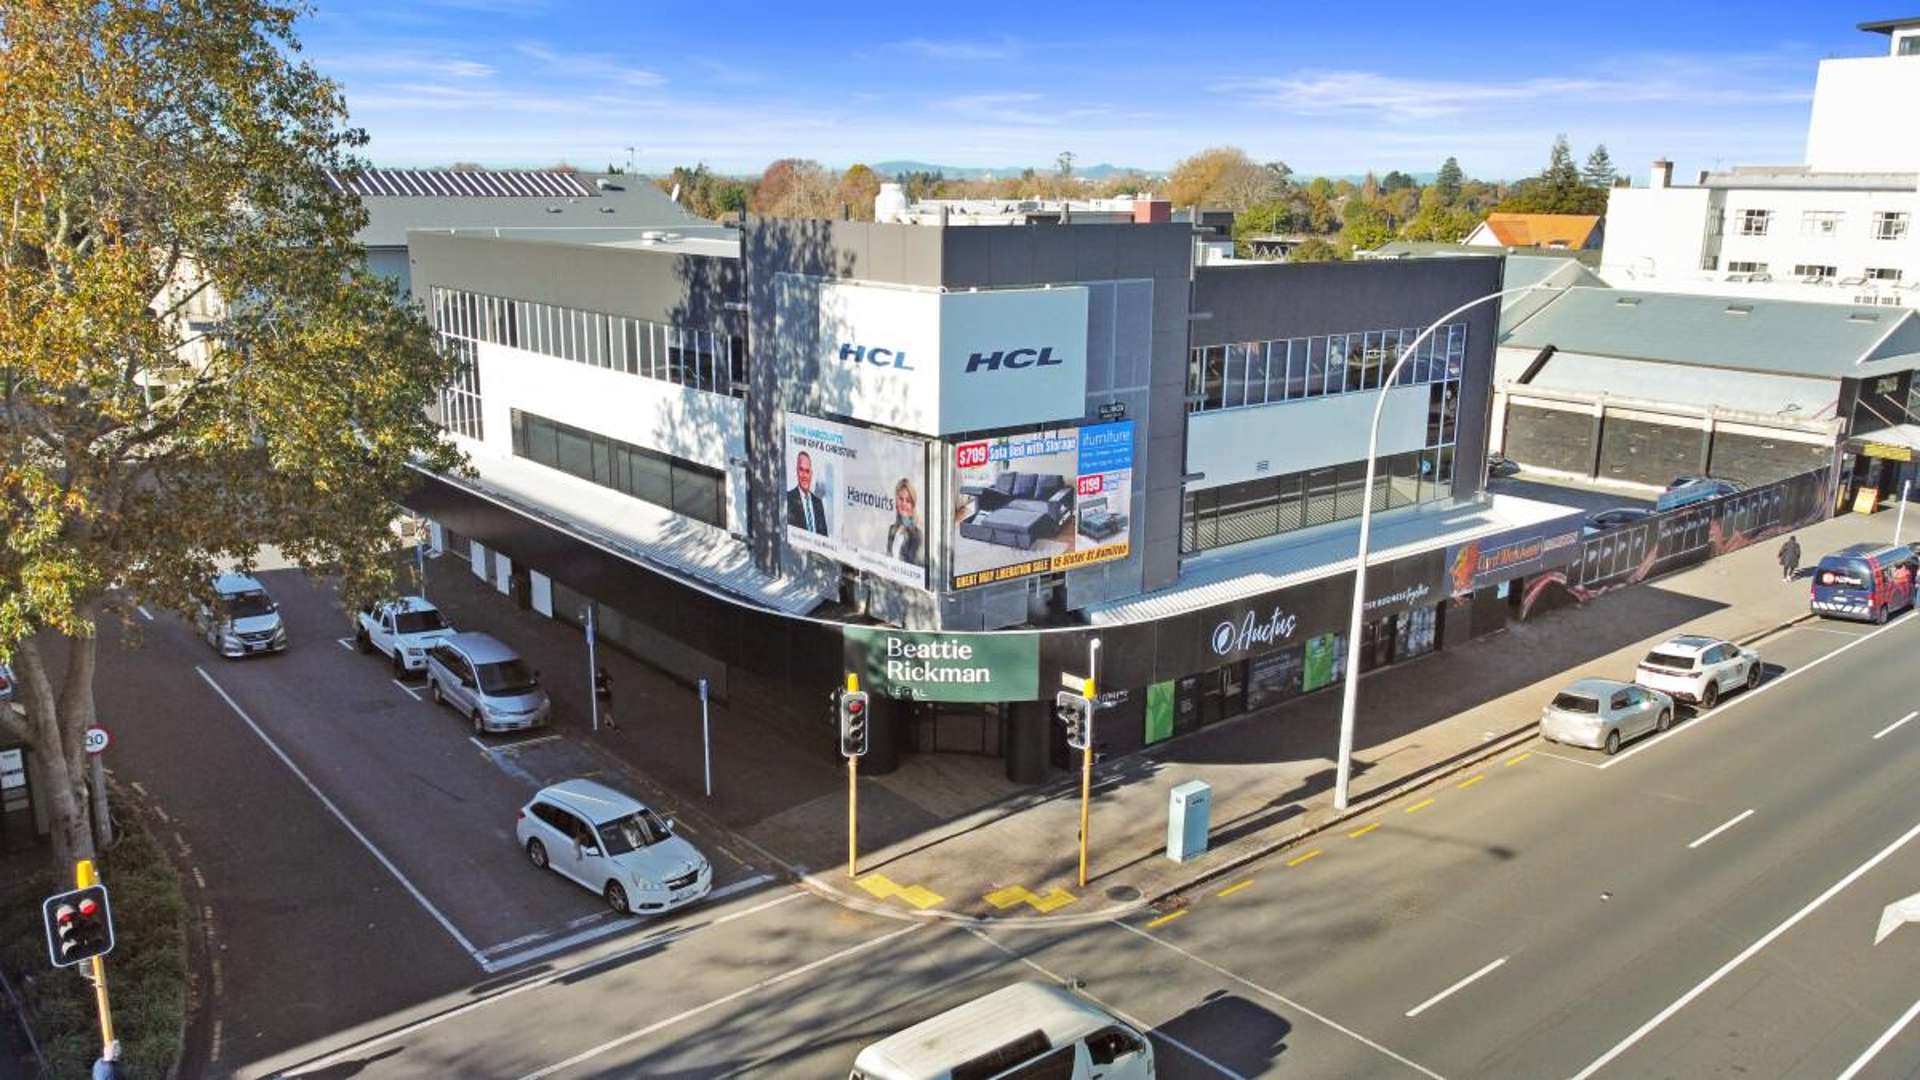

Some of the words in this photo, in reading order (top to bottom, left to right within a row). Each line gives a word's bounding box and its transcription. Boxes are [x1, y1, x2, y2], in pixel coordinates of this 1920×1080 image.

[839, 343, 914, 371] HCL
[965, 347, 1064, 373] HCL
[959, 446, 987, 465] $709
[847, 485, 894, 511] Harcourts
[1235, 606, 1297, 650] Auctus
[887, 636, 973, 660] Beattie
[887, 660, 991, 683] Rickman
[86, 733, 104, 746] 30
